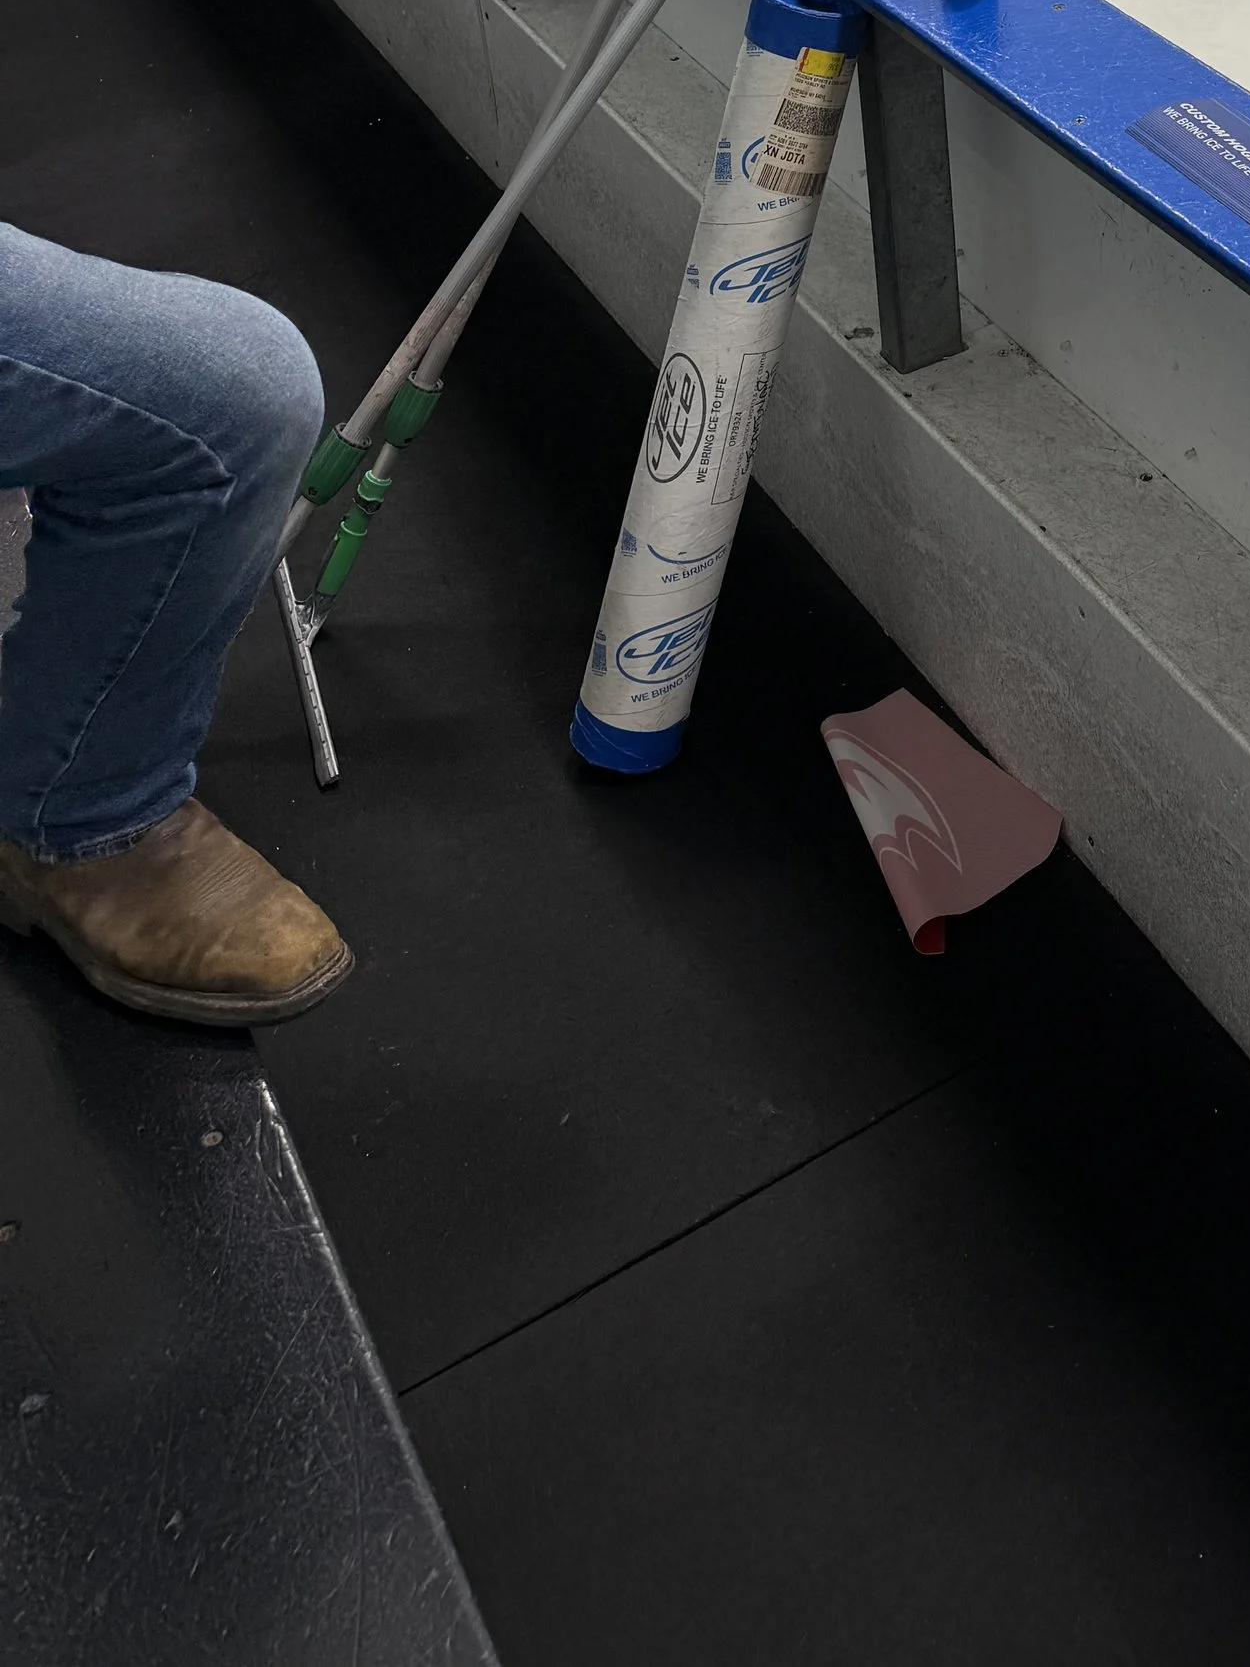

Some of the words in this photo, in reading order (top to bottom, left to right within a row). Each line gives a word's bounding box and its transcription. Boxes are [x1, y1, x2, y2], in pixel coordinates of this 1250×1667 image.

[1180, 102, 1230, 138] CUSTOM
[1162, 106, 1182, 120] WE
[1176, 117, 1208, 140] BRING
[1204, 137, 1223, 151] ICE
[1219, 149, 1235, 161] TO
[764, 144, 779, 157] XN
[780, 151, 806, 165] JDTA
[758, 199, 777, 212] WE
[715, 378, 727, 399] LIFE
[712, 400, 722, 416] TO
[707, 416, 718, 434] ICE
[700, 431, 714, 466] BRING
[696, 467, 706, 483] WE
[661, 573, 680, 584] WE
[682, 558, 714, 579] BRING
[631, 692, 649, 703] WE
[652, 678, 683, 699] BRING
